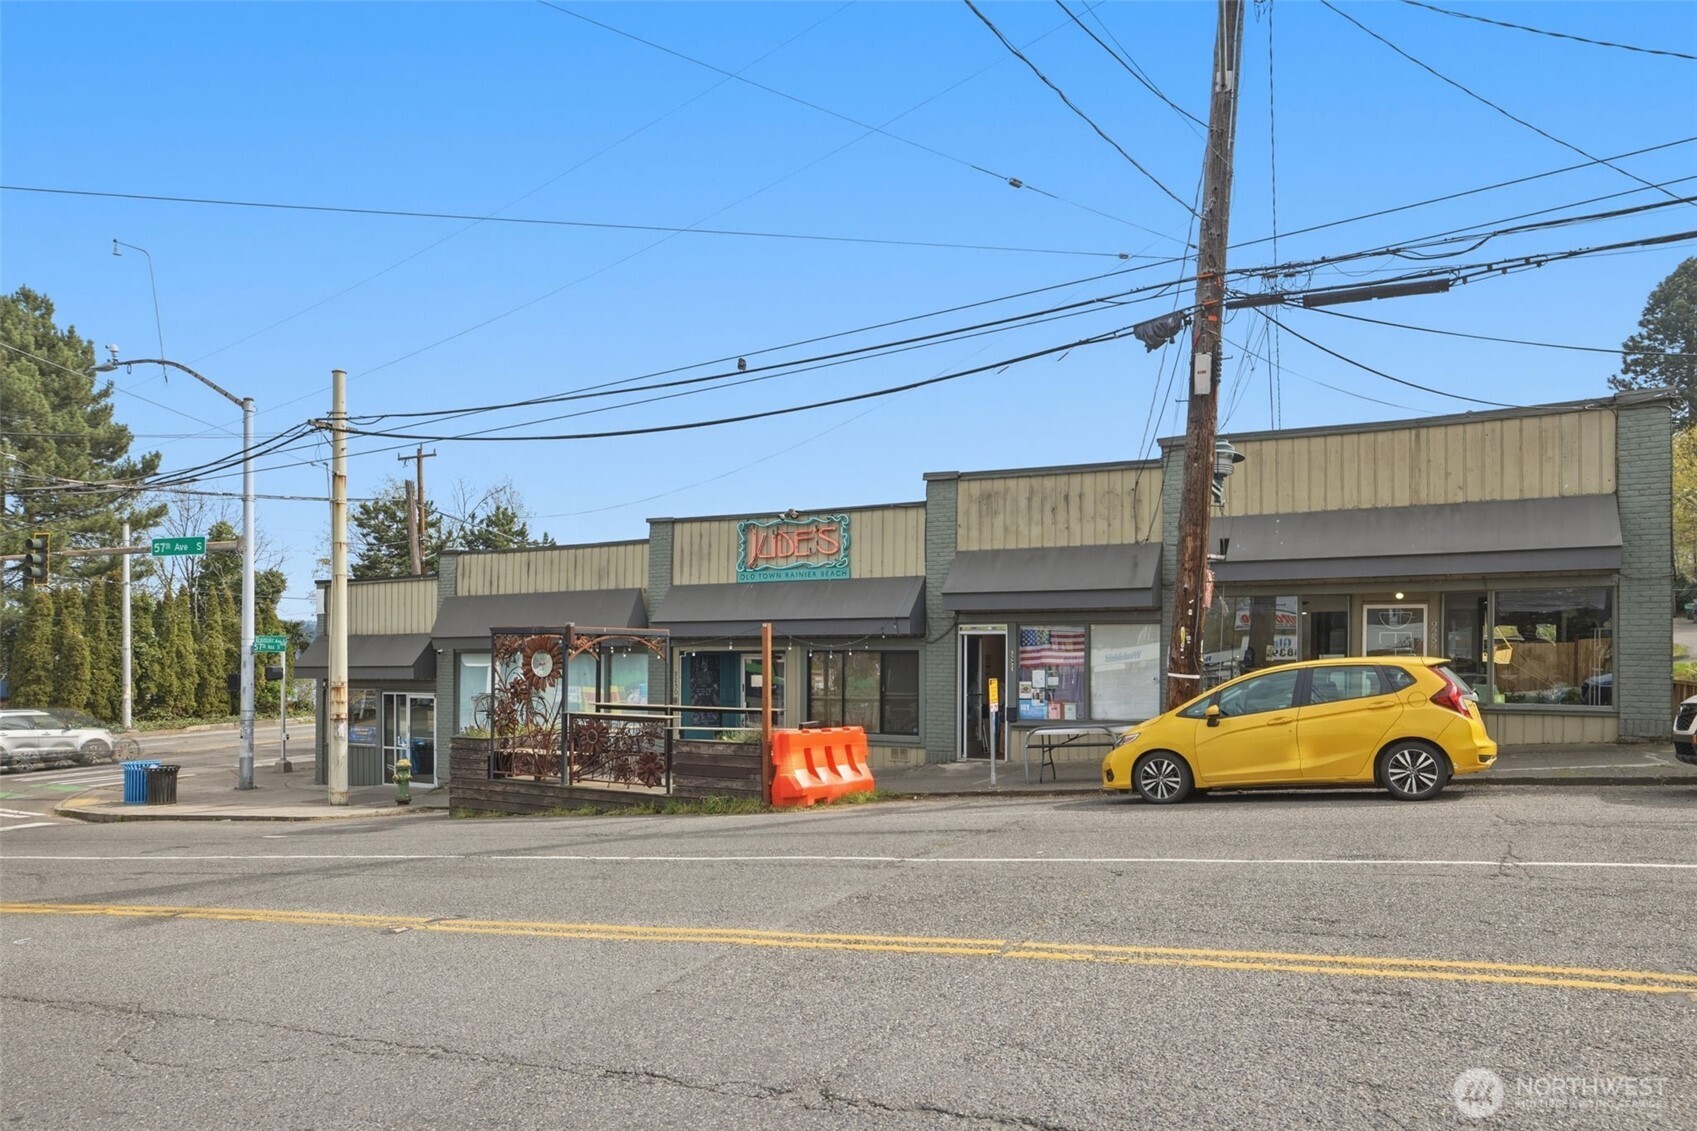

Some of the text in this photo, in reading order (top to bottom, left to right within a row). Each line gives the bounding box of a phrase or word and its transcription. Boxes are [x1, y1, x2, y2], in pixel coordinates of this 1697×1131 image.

[174, 543, 188, 551] Ave
[196, 542, 203, 551] S
[747, 526, 840, 568] JUDE'S
